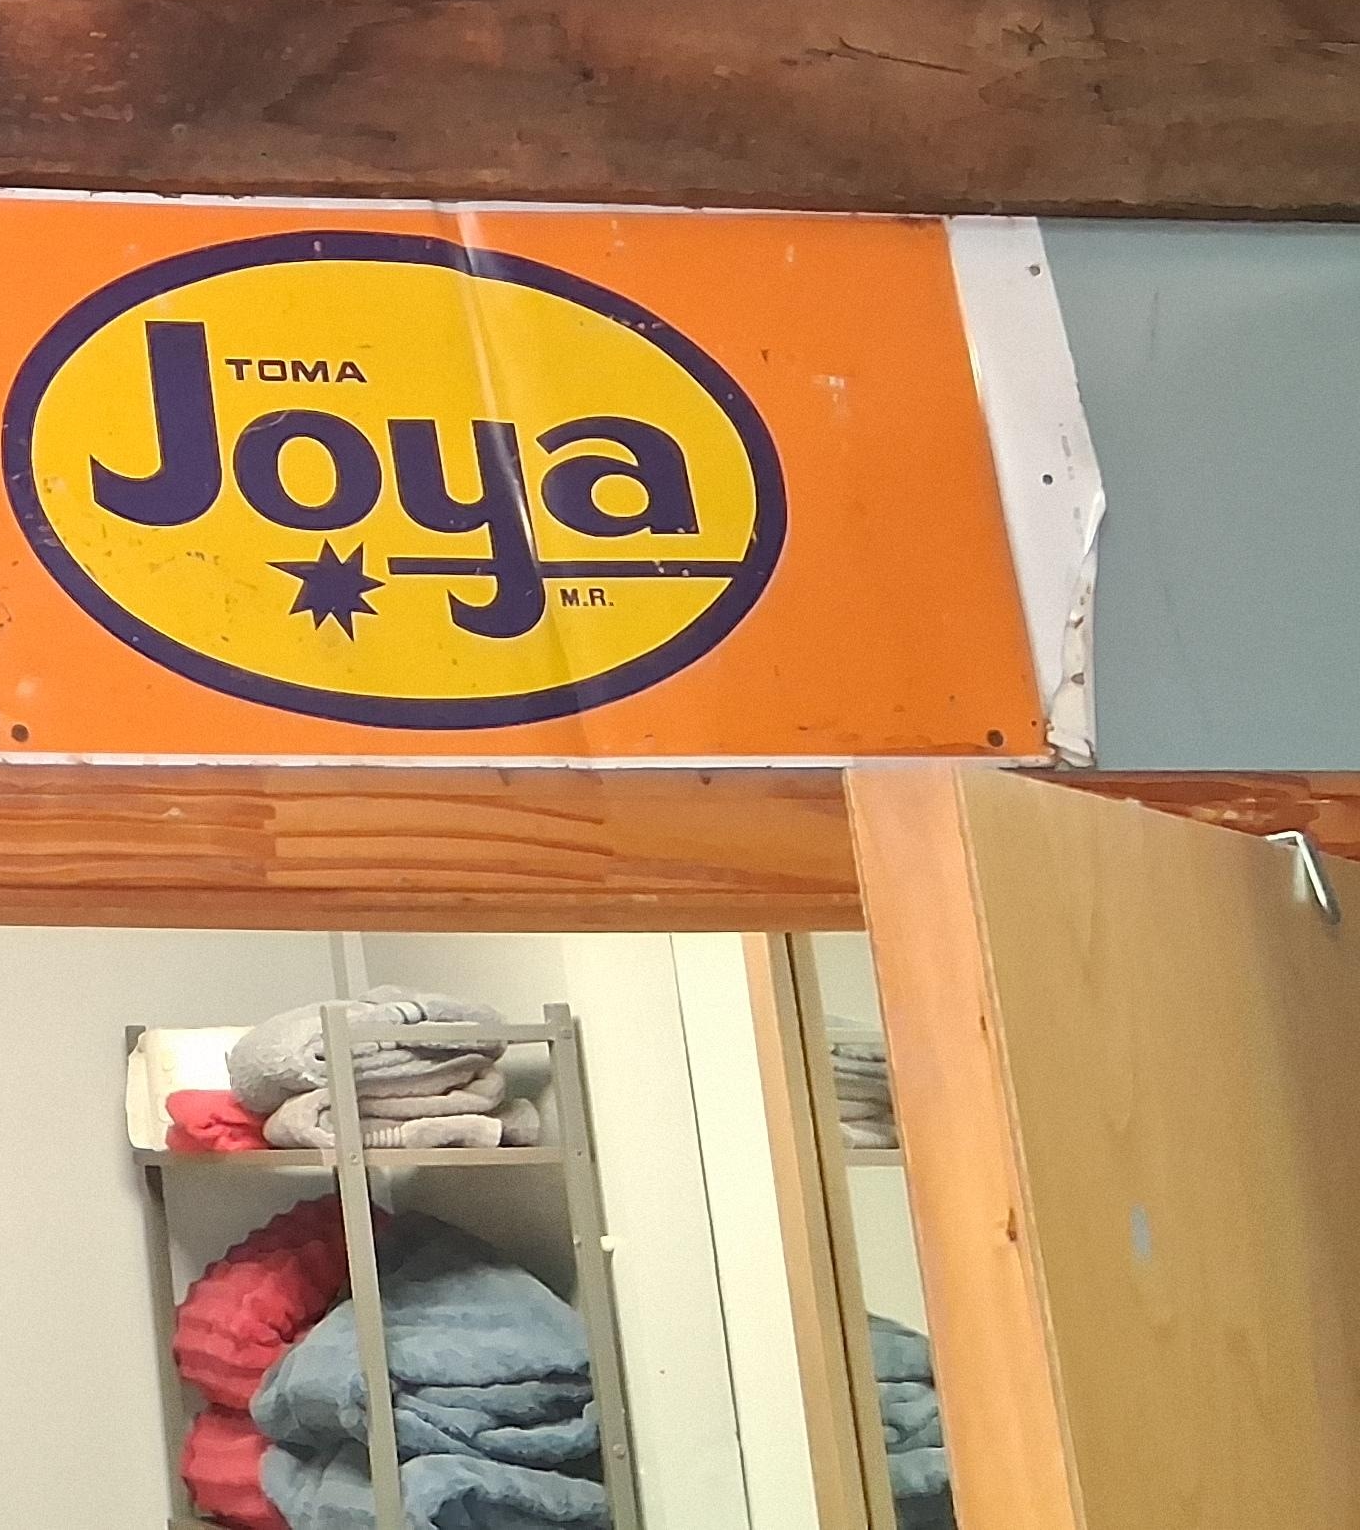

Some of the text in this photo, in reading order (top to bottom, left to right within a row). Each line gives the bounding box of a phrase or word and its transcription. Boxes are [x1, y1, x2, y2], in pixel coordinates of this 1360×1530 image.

[225, 358, 368, 384] TOMA
[90, 320, 700, 639] Joya
[560, 588, 615, 609] M.R.
